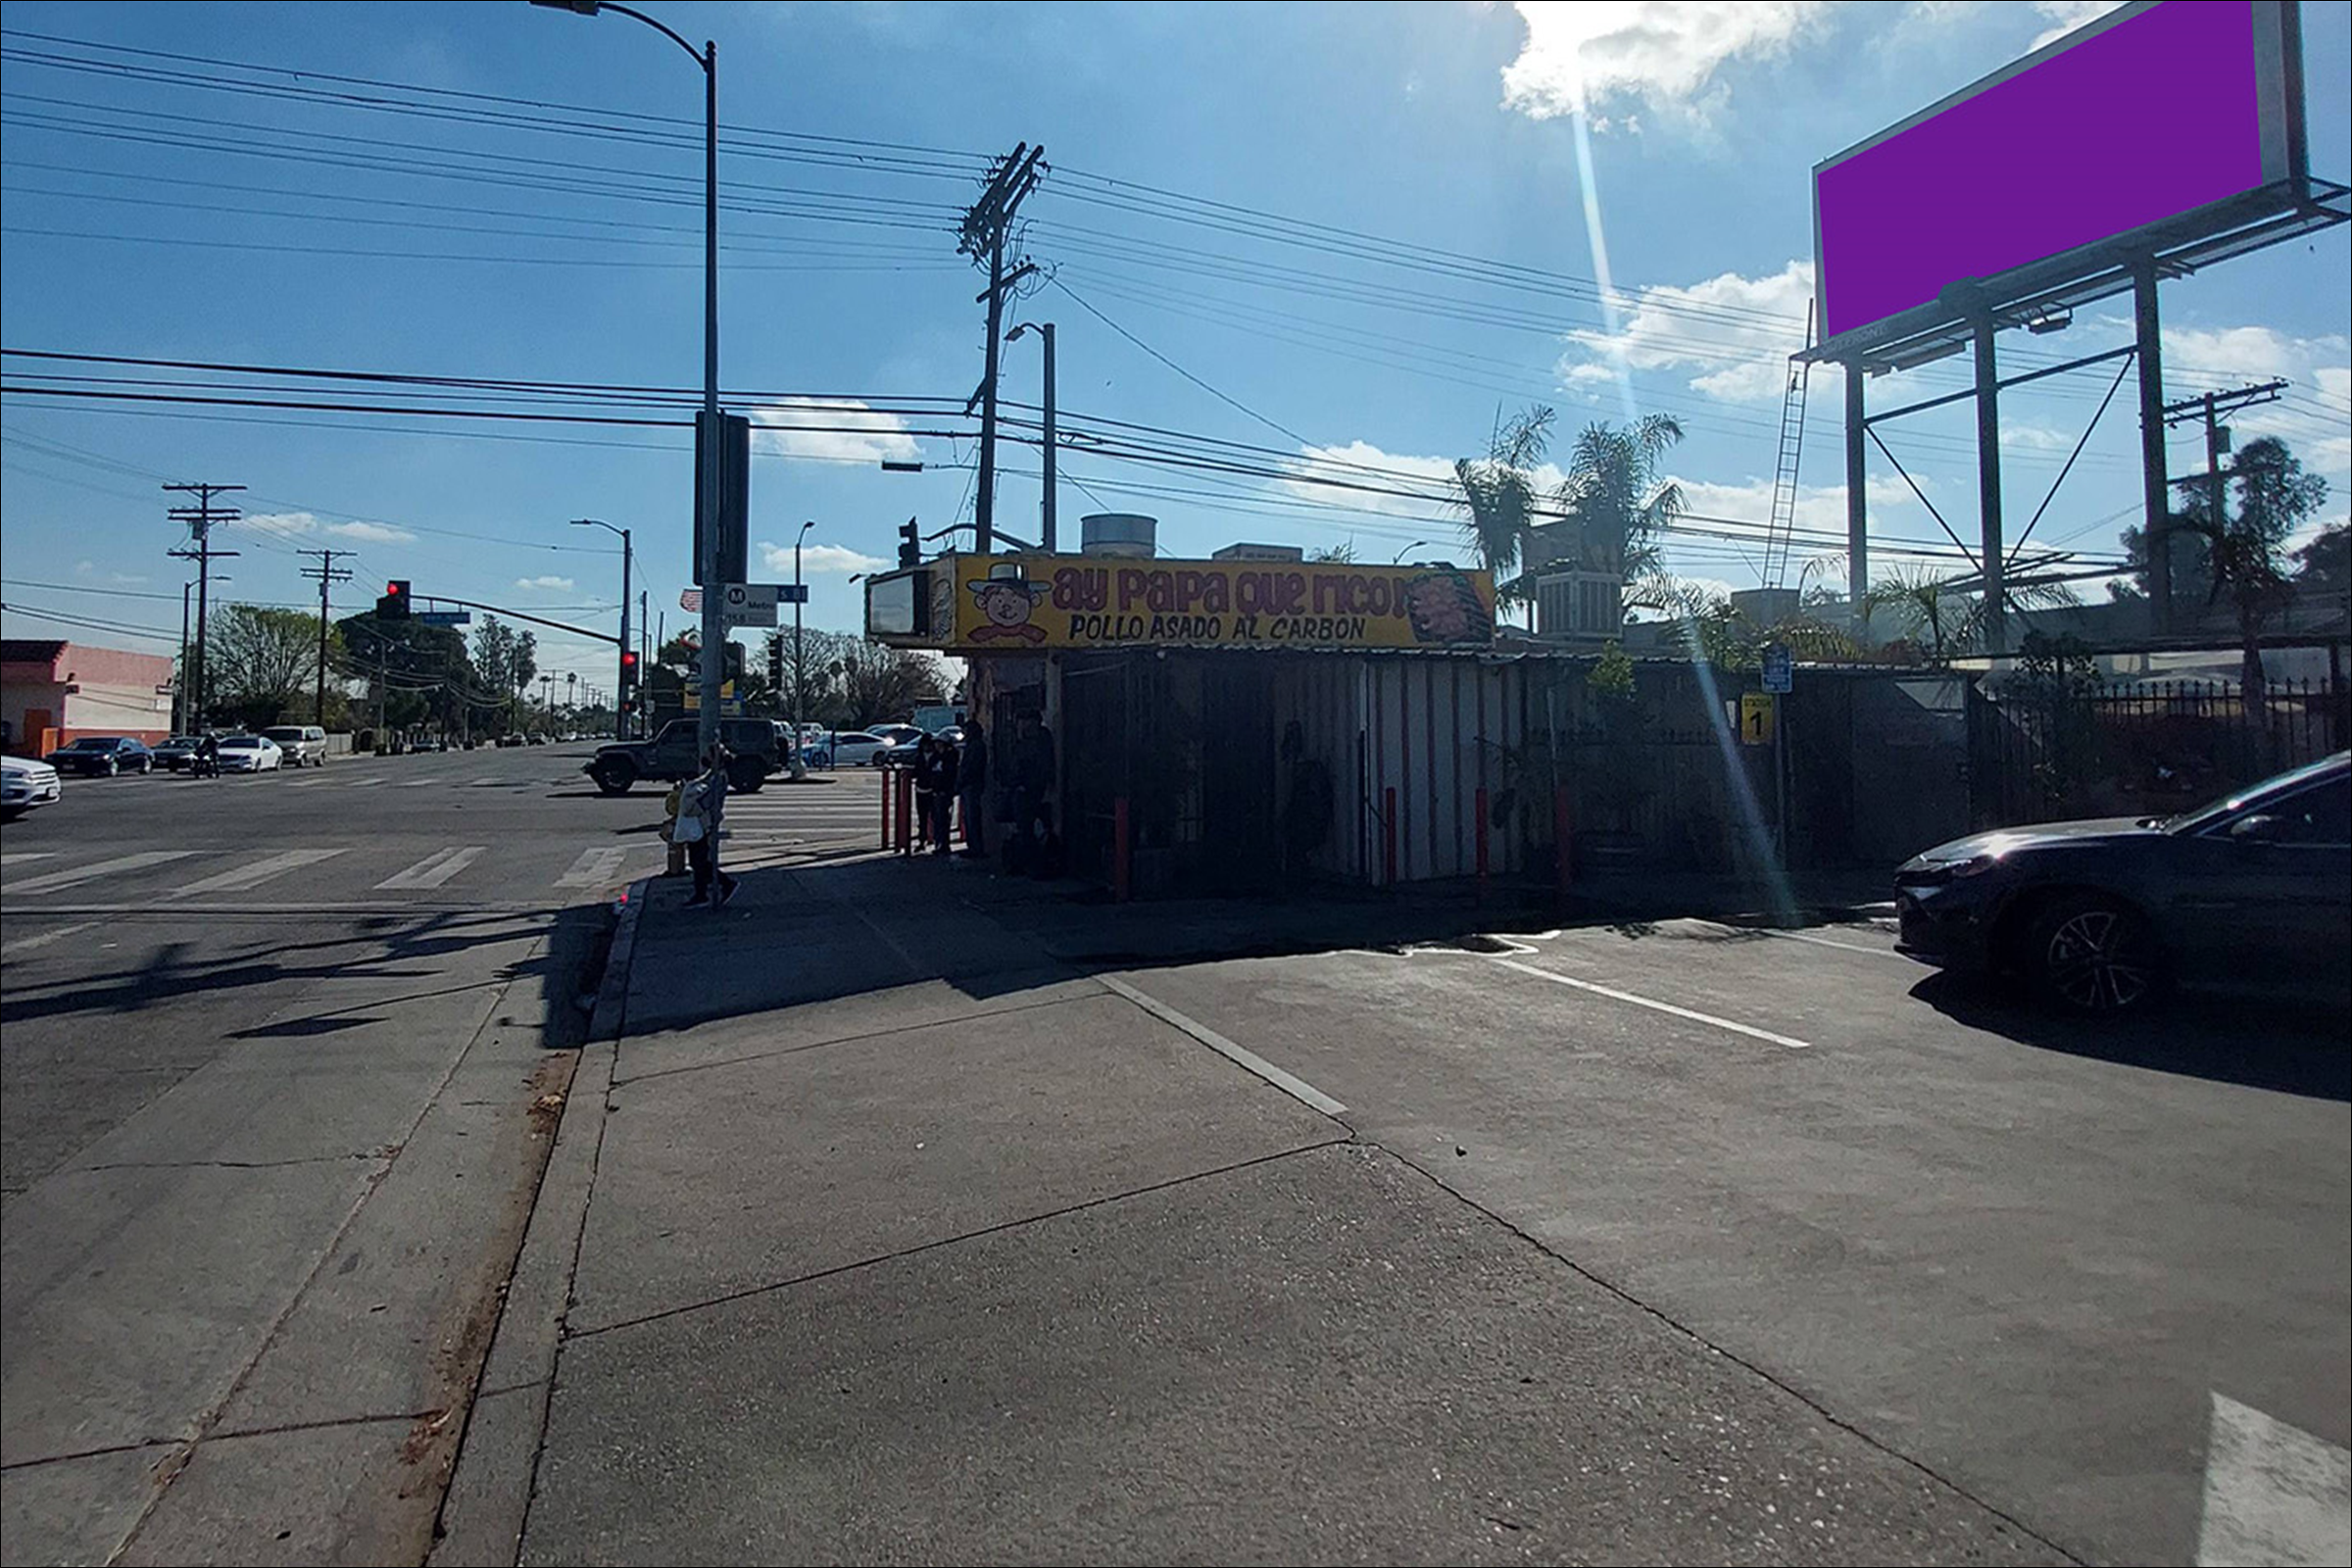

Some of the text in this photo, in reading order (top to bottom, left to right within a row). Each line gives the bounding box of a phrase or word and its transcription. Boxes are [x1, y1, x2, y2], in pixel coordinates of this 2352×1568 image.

[1069, 615, 1366, 640] POLLO ASADO AL CARBON
[1749, 710, 1761, 736] 1
